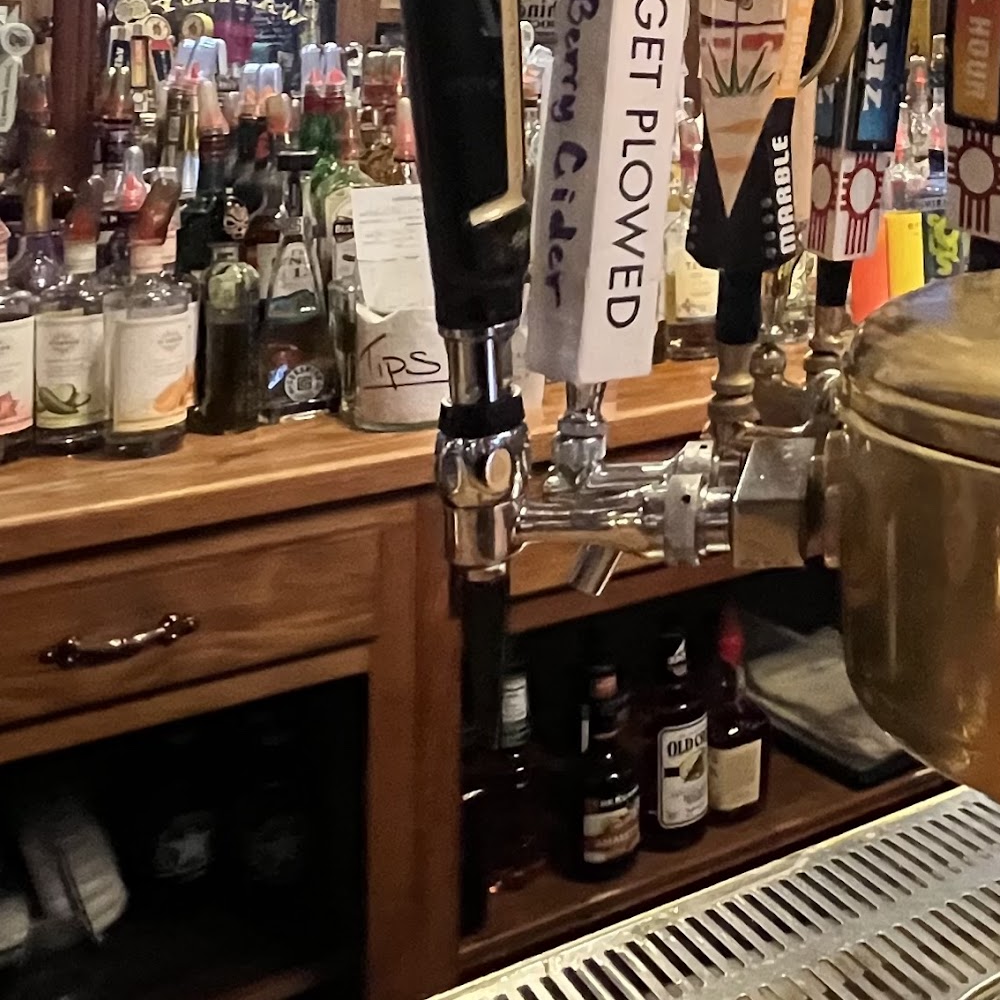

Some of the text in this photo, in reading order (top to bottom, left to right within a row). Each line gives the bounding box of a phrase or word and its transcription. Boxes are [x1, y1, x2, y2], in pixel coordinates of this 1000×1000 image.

[965, 15, 995, 101] HOUR
[545, 140, 588, 308] Cider
[606, 109, 659, 330] PLOWED
[771, 134, 798, 257] MARBLE
[667, 737, 694, 758] OLD
